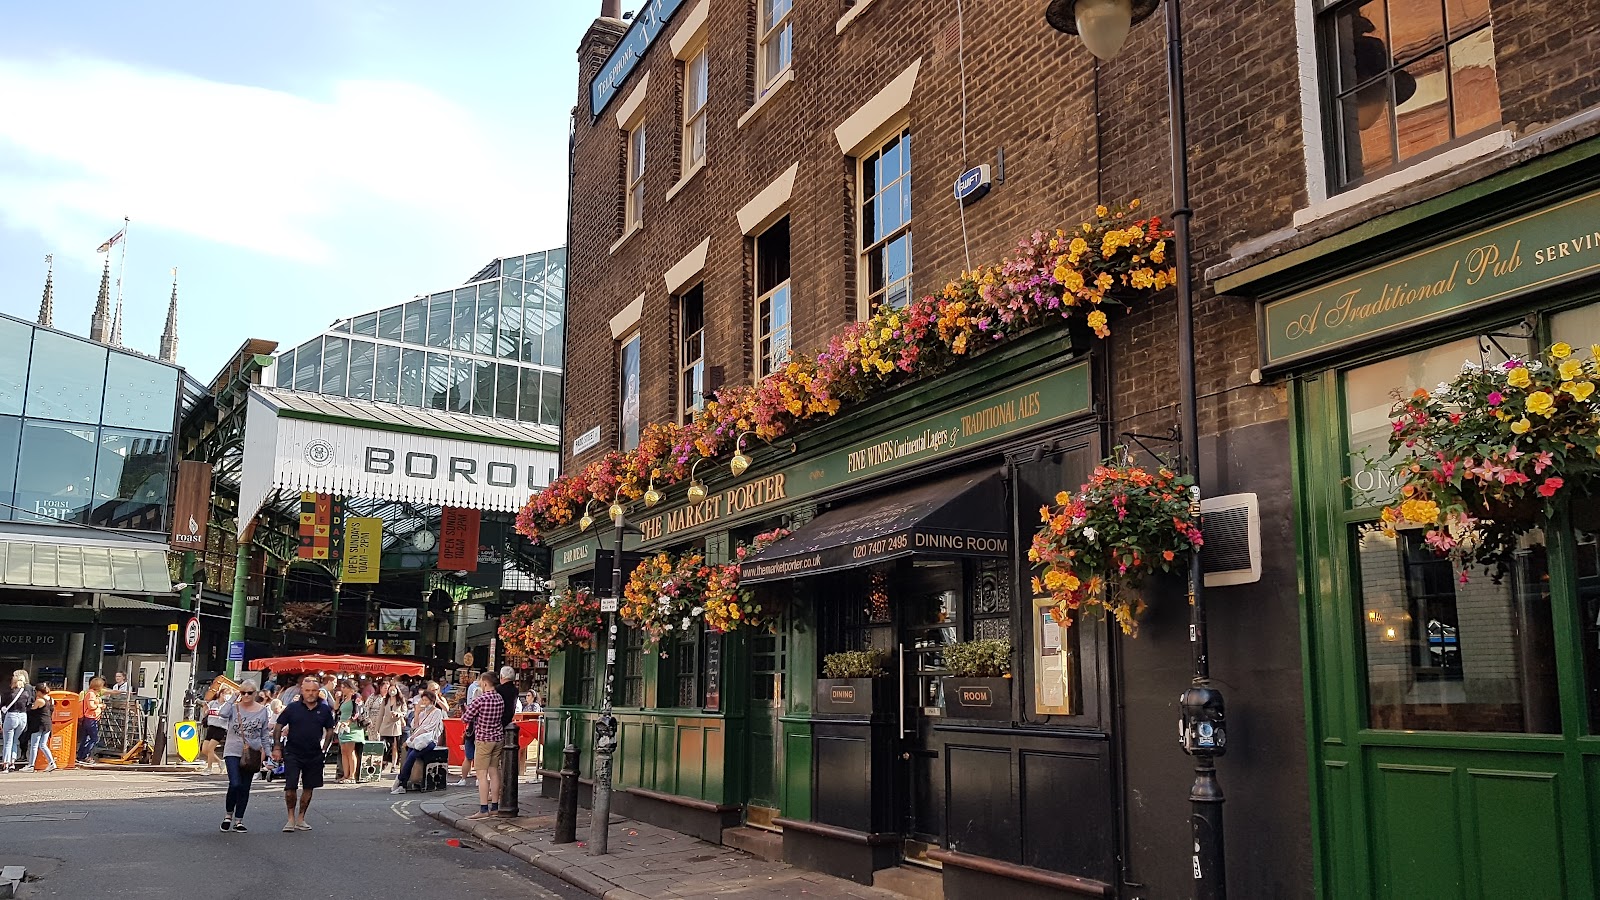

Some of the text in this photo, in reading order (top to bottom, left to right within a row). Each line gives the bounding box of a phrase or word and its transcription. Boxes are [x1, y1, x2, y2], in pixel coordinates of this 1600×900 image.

[597, 43, 634, 98] TELEPHONE
[1285, 301, 1323, 340] A
[1324, 260, 1460, 329] Traditional
[1464, 239, 1523, 286] Pub
[847, 391, 1041, 473] FINE WINES Continental Lagers & TRADITIONAL ALES
[364, 446, 554, 491] BOROU
[34, 500, 73, 520] bar
[43, 499, 70, 508] roast
[639, 473, 786, 542] THE MARKET PORTER
[456, 514, 467, 531] 2PM
[175, 533, 202, 543] roast
[348, 522, 361, 574] OPEN SUNDAYS
[360, 532, 370, 548] 2PM
[852, 534, 908, 559] 020 7407 2495
[915, 533, 1008, 552] DINING ROOM
[444, 538, 455, 559] OPEN
[455, 539, 465, 559] 10AM
[358, 555, 368, 574] 10AM
[742, 555, 821, 578] www.themarketporter.co.uk
[2, 635, 55, 644] NGER PIG
[832, 690, 853, 698] DINING
[963, 692, 987, 701] ROOM
